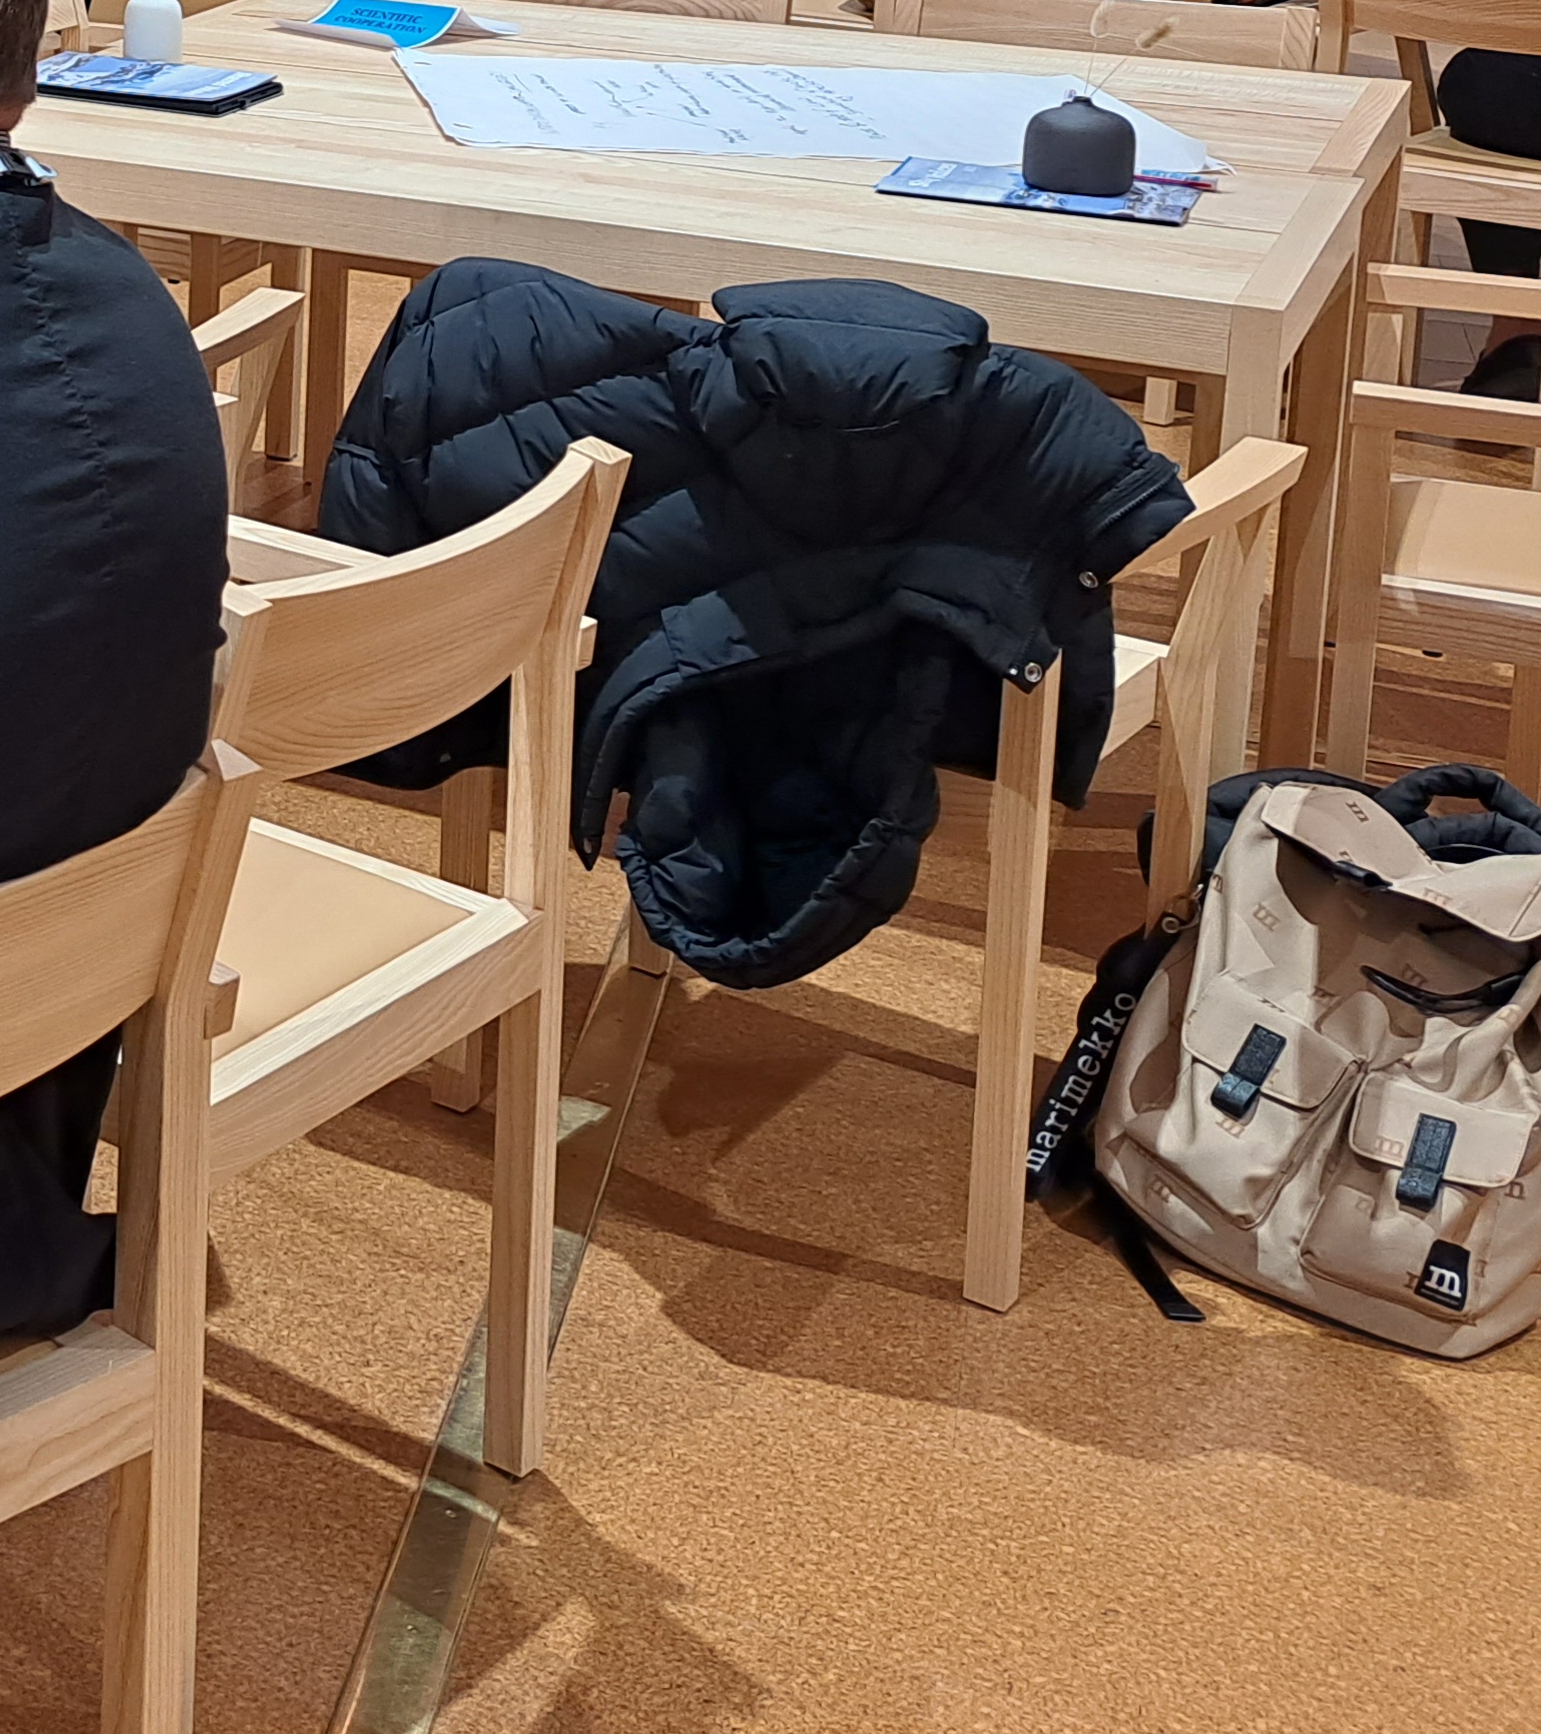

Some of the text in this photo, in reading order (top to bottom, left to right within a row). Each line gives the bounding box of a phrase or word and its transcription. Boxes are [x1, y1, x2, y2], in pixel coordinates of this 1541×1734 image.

[334, 15, 427, 34] COOPERATION
[351, 7, 424, 24] SCIENTIFIC
[1025, 992, 1137, 1173] marimekko
[1423, 1264, 1462, 1298] m
